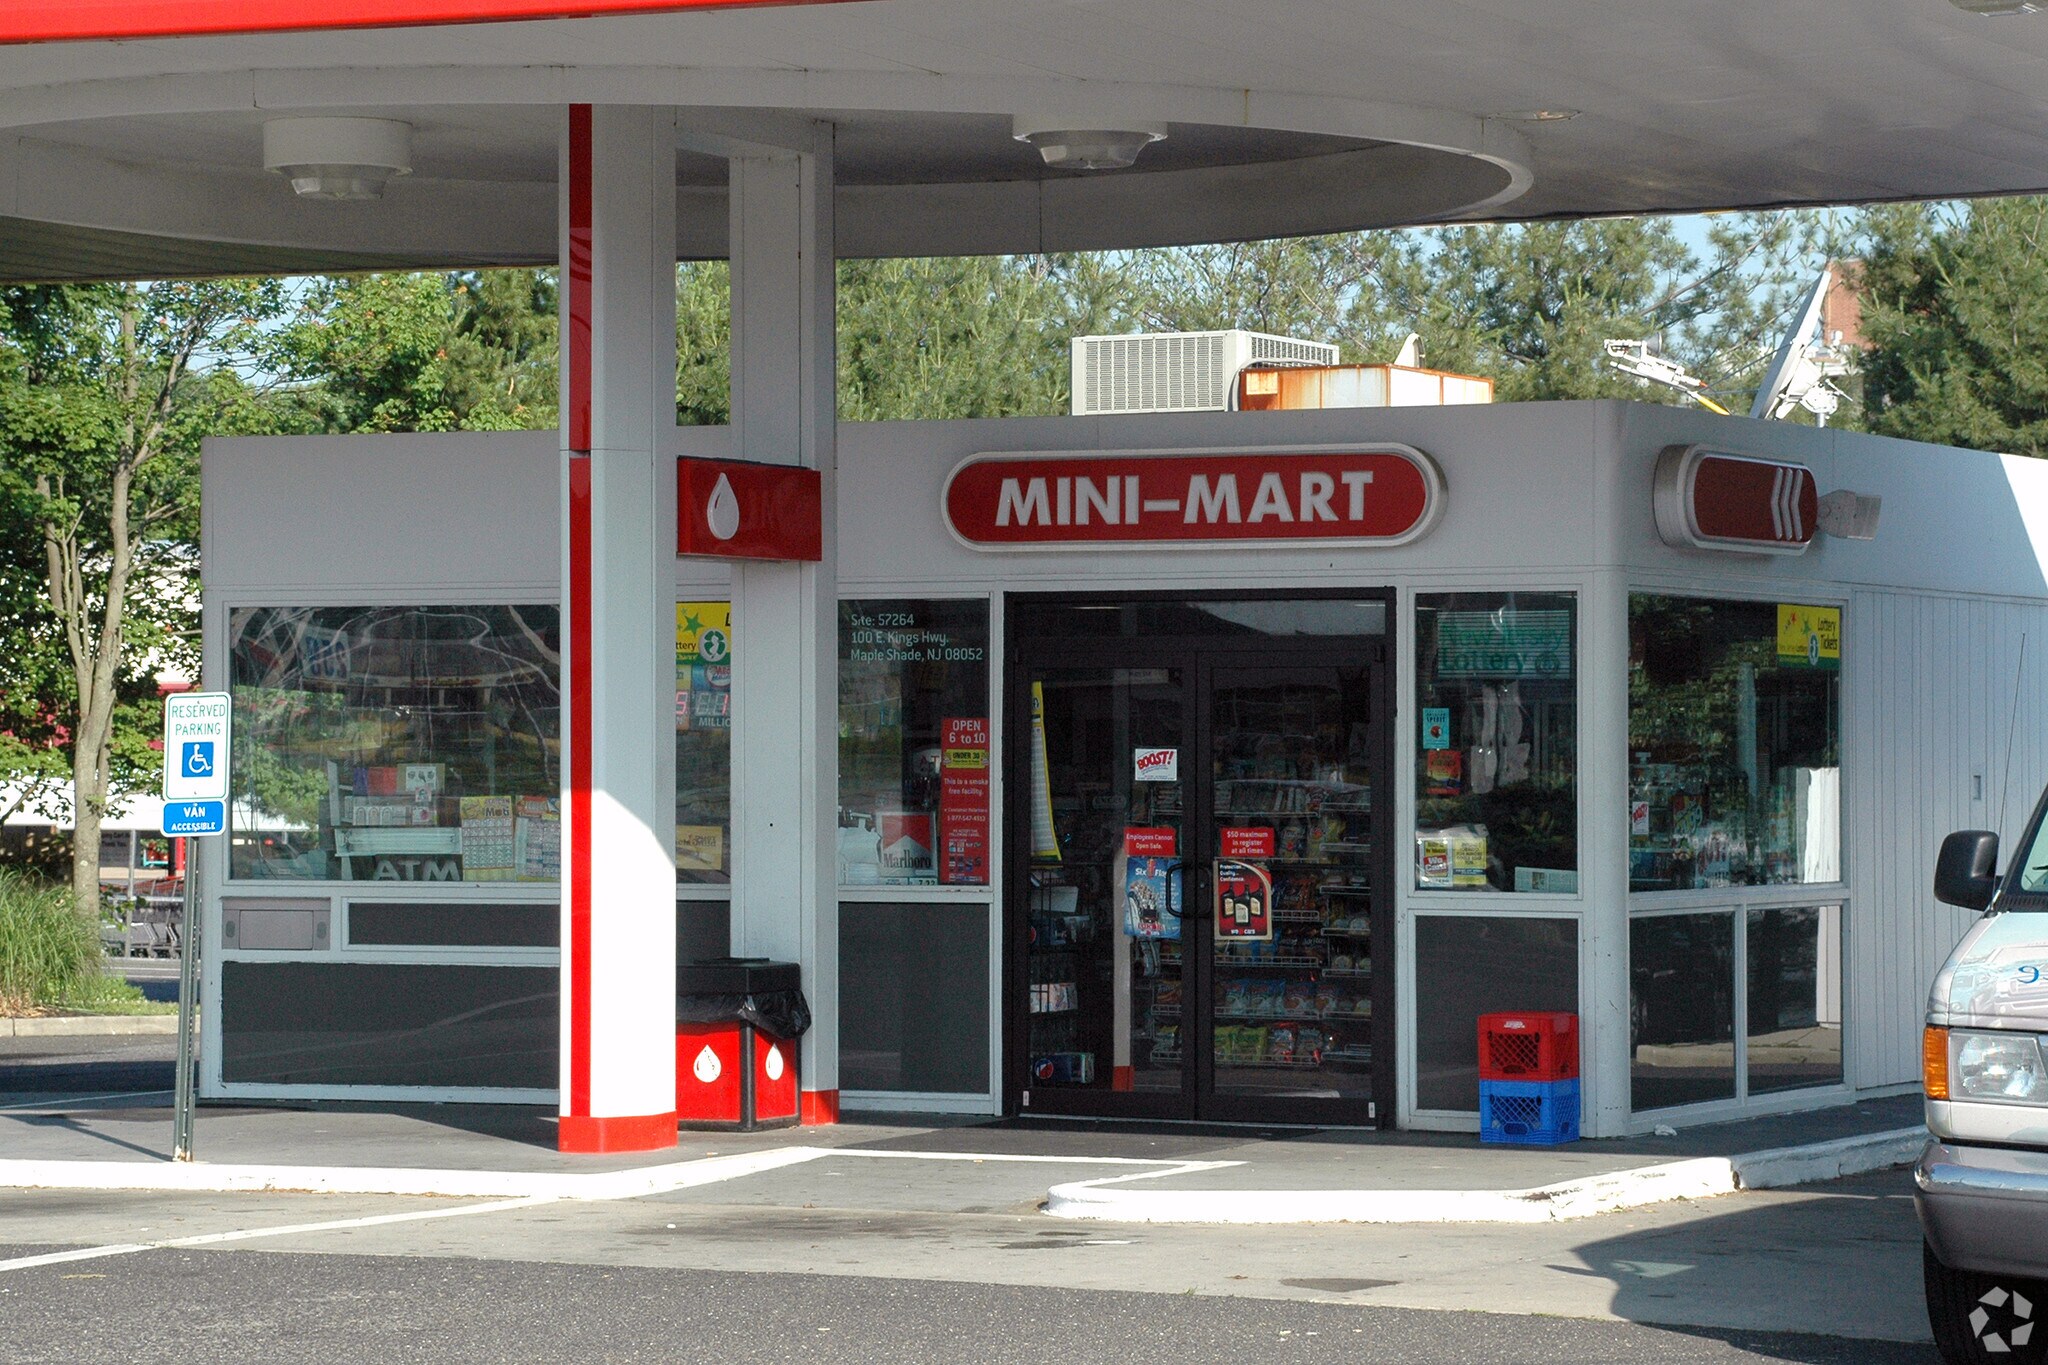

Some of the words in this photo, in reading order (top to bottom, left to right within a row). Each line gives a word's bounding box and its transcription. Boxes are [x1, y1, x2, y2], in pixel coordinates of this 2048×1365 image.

[995, 470, 1374, 526] MINI-MART
[851, 613, 875, 625] Site:
[878, 613, 914, 625] 57264
[851, 631, 873, 643] 100
[888, 630, 919, 647] Kings
[922, 630, 949, 646] Hwy.
[676, 641, 697, 651] ttery
[850, 649, 884, 664] Maple
[886, 648, 924, 662] Shade,
[927, 648, 941, 660] NJ
[945, 648, 983, 660] 08052
[172, 704, 226, 718] RESERVED
[698, 717, 731, 727] MILLIO
[952, 720, 981, 731] OPEN
[175, 722, 221, 736] PARKING
[949, 732, 956, 743] 6
[960, 734, 971, 744] to
[973, 732, 986, 744] 10
[1137, 750, 1175, 770] BOOST!
[182, 806, 206, 818] VAN
[171, 821, 216, 832] ACCESSIBLE
[1240, 839, 1263, 848] register
[883, 849, 931, 868] Marlboro
[375, 858, 461, 881] ATM
